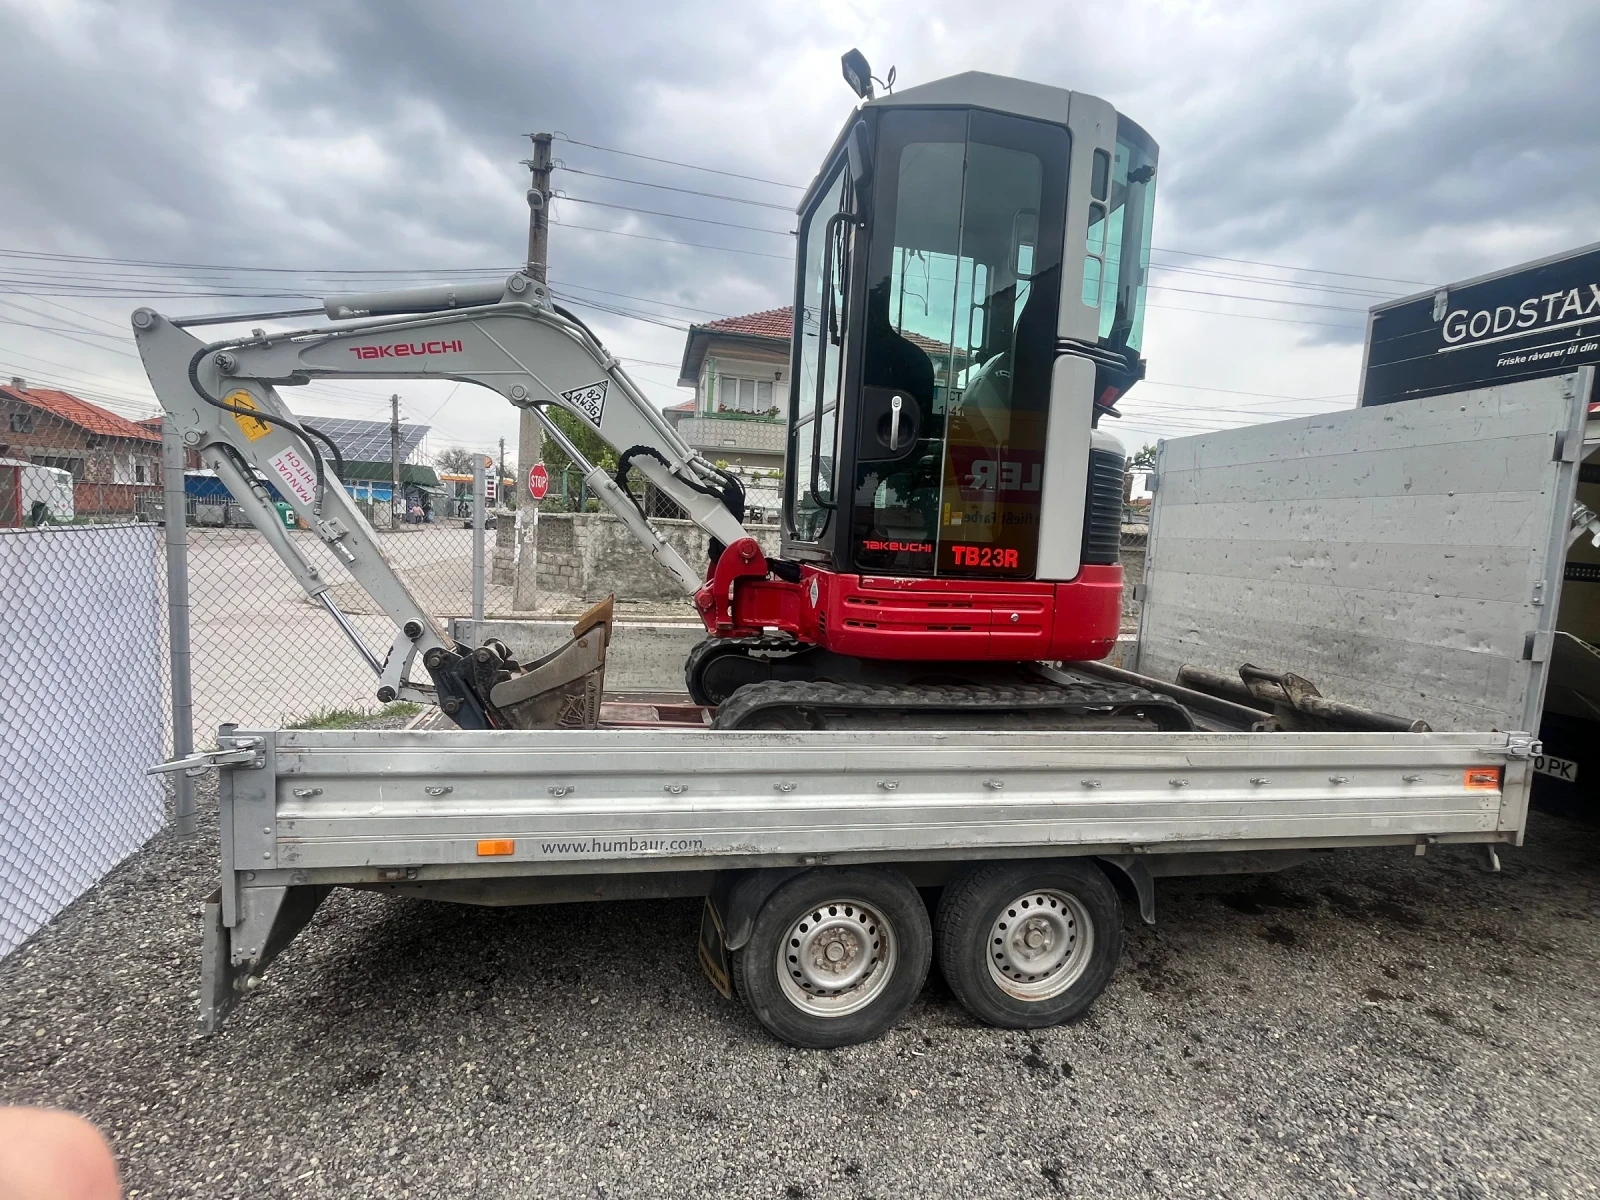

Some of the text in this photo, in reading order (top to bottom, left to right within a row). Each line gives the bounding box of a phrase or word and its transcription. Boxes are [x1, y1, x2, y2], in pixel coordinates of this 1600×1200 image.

[1496, 342, 1597, 367] Friske råvarer til din
[587, 389, 602, 404] 82
[938, 405, 963, 416] 141
[274, 458, 311, 503] MANUAL
[531, 475, 546, 488] STOP
[952, 545, 1018, 568] TB23R
[1548, 758, 1573, 780] PK
[541, 837, 703, 853] www.humbaur.com
